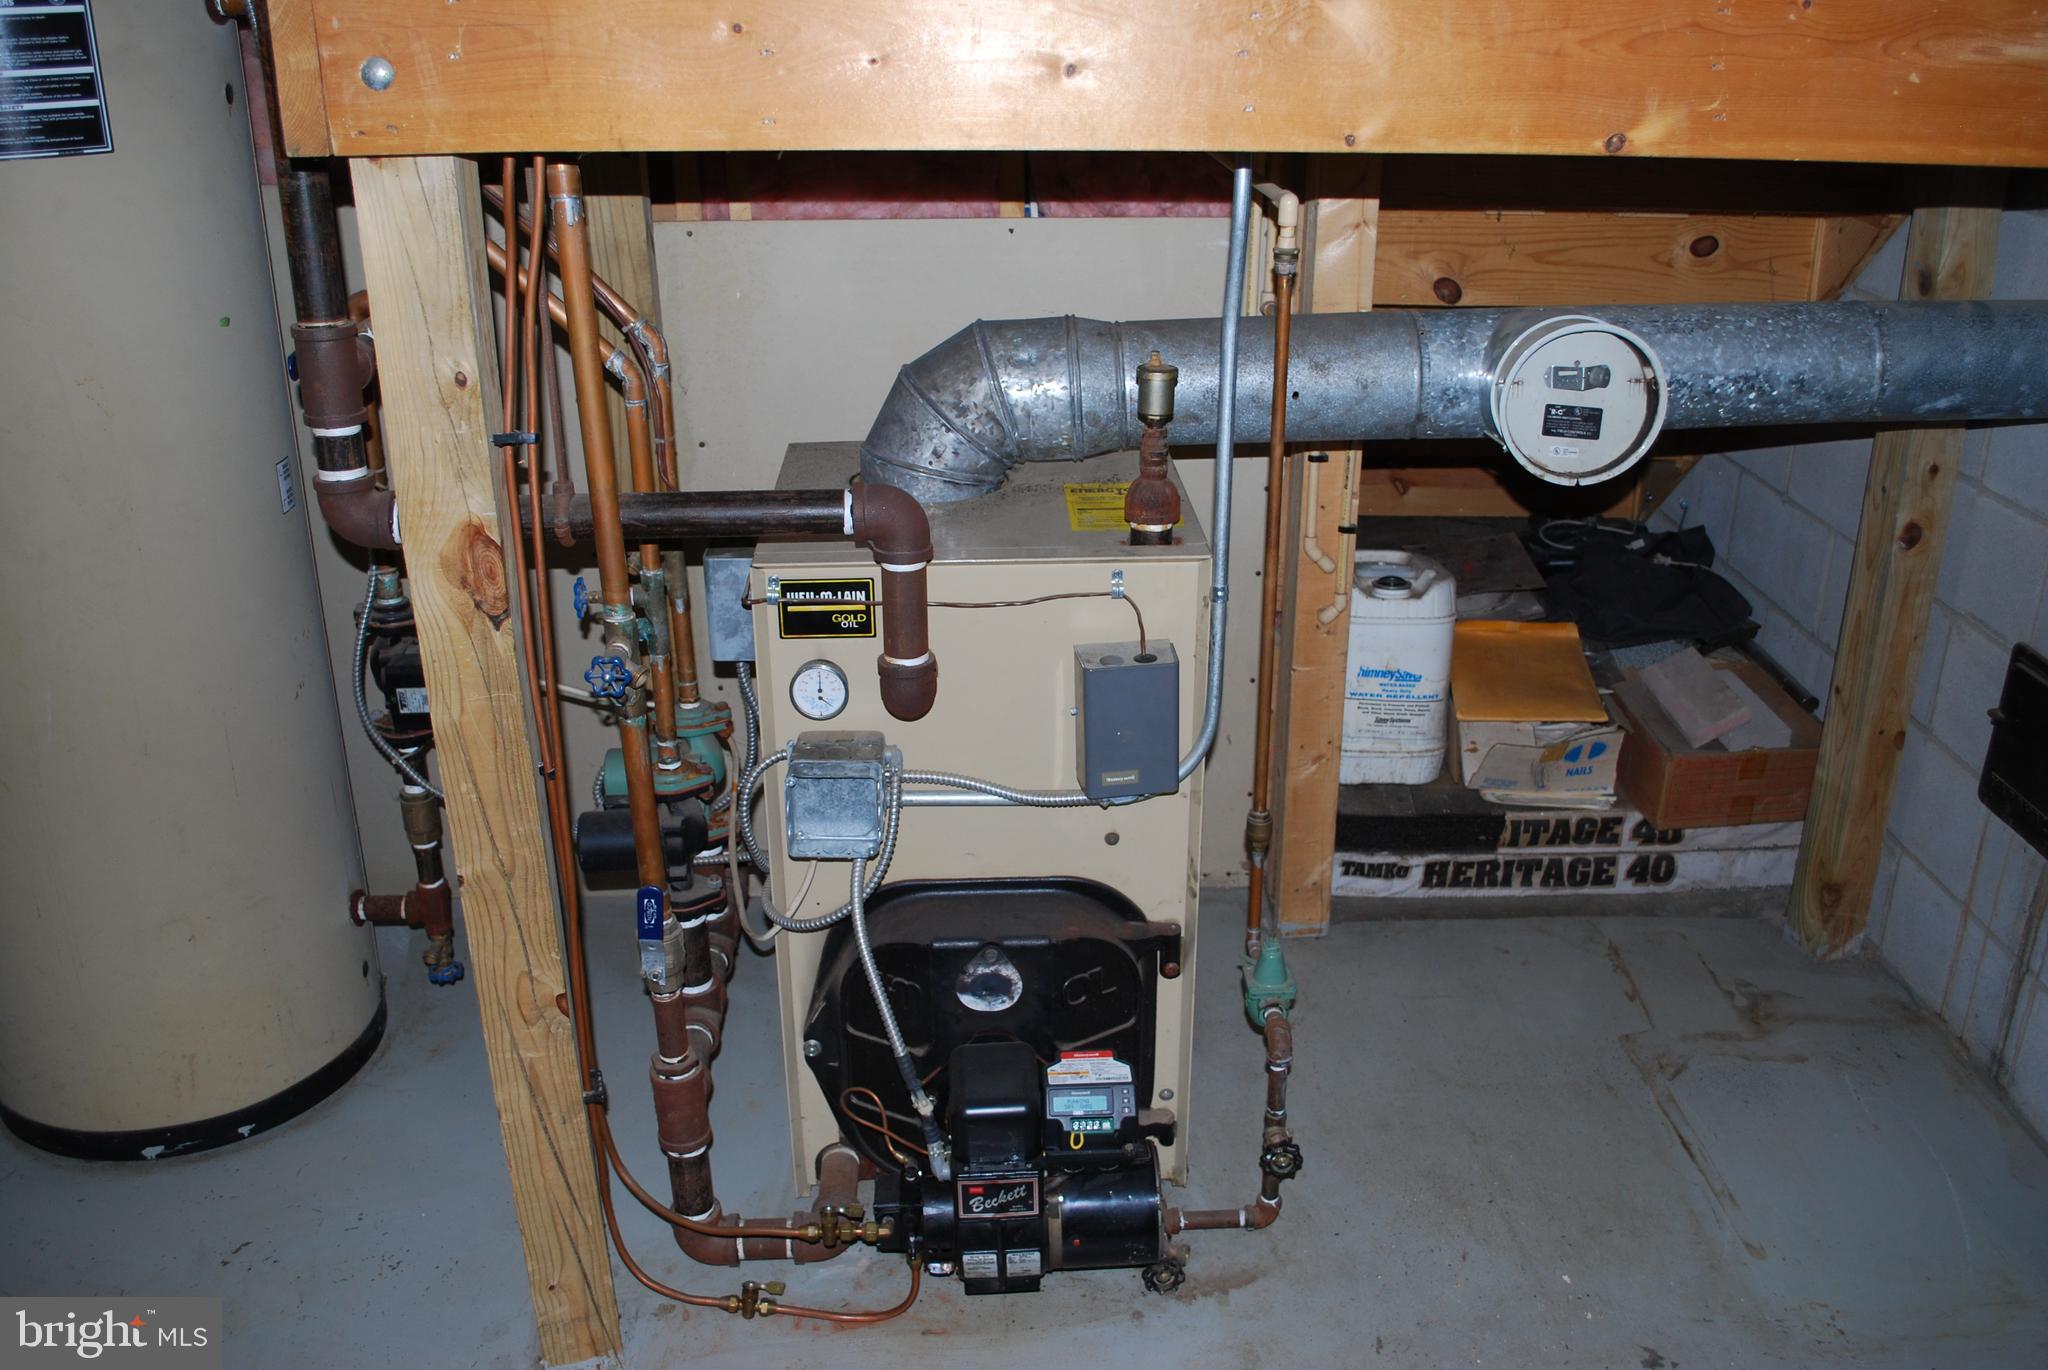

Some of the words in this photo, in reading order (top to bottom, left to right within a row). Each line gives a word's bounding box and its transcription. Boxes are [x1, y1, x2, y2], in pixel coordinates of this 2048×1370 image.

[831, 613, 867, 623] GOLD
[841, 621, 859, 629] OIL
[1349, 691, 1383, 699] WATER
[1565, 766, 1593, 777] NAILS
[1421, 856, 1617, 888] HERITAGE
[1626, 854, 1677, 884] 40
[969, 1184, 1027, 1212] Beckett
